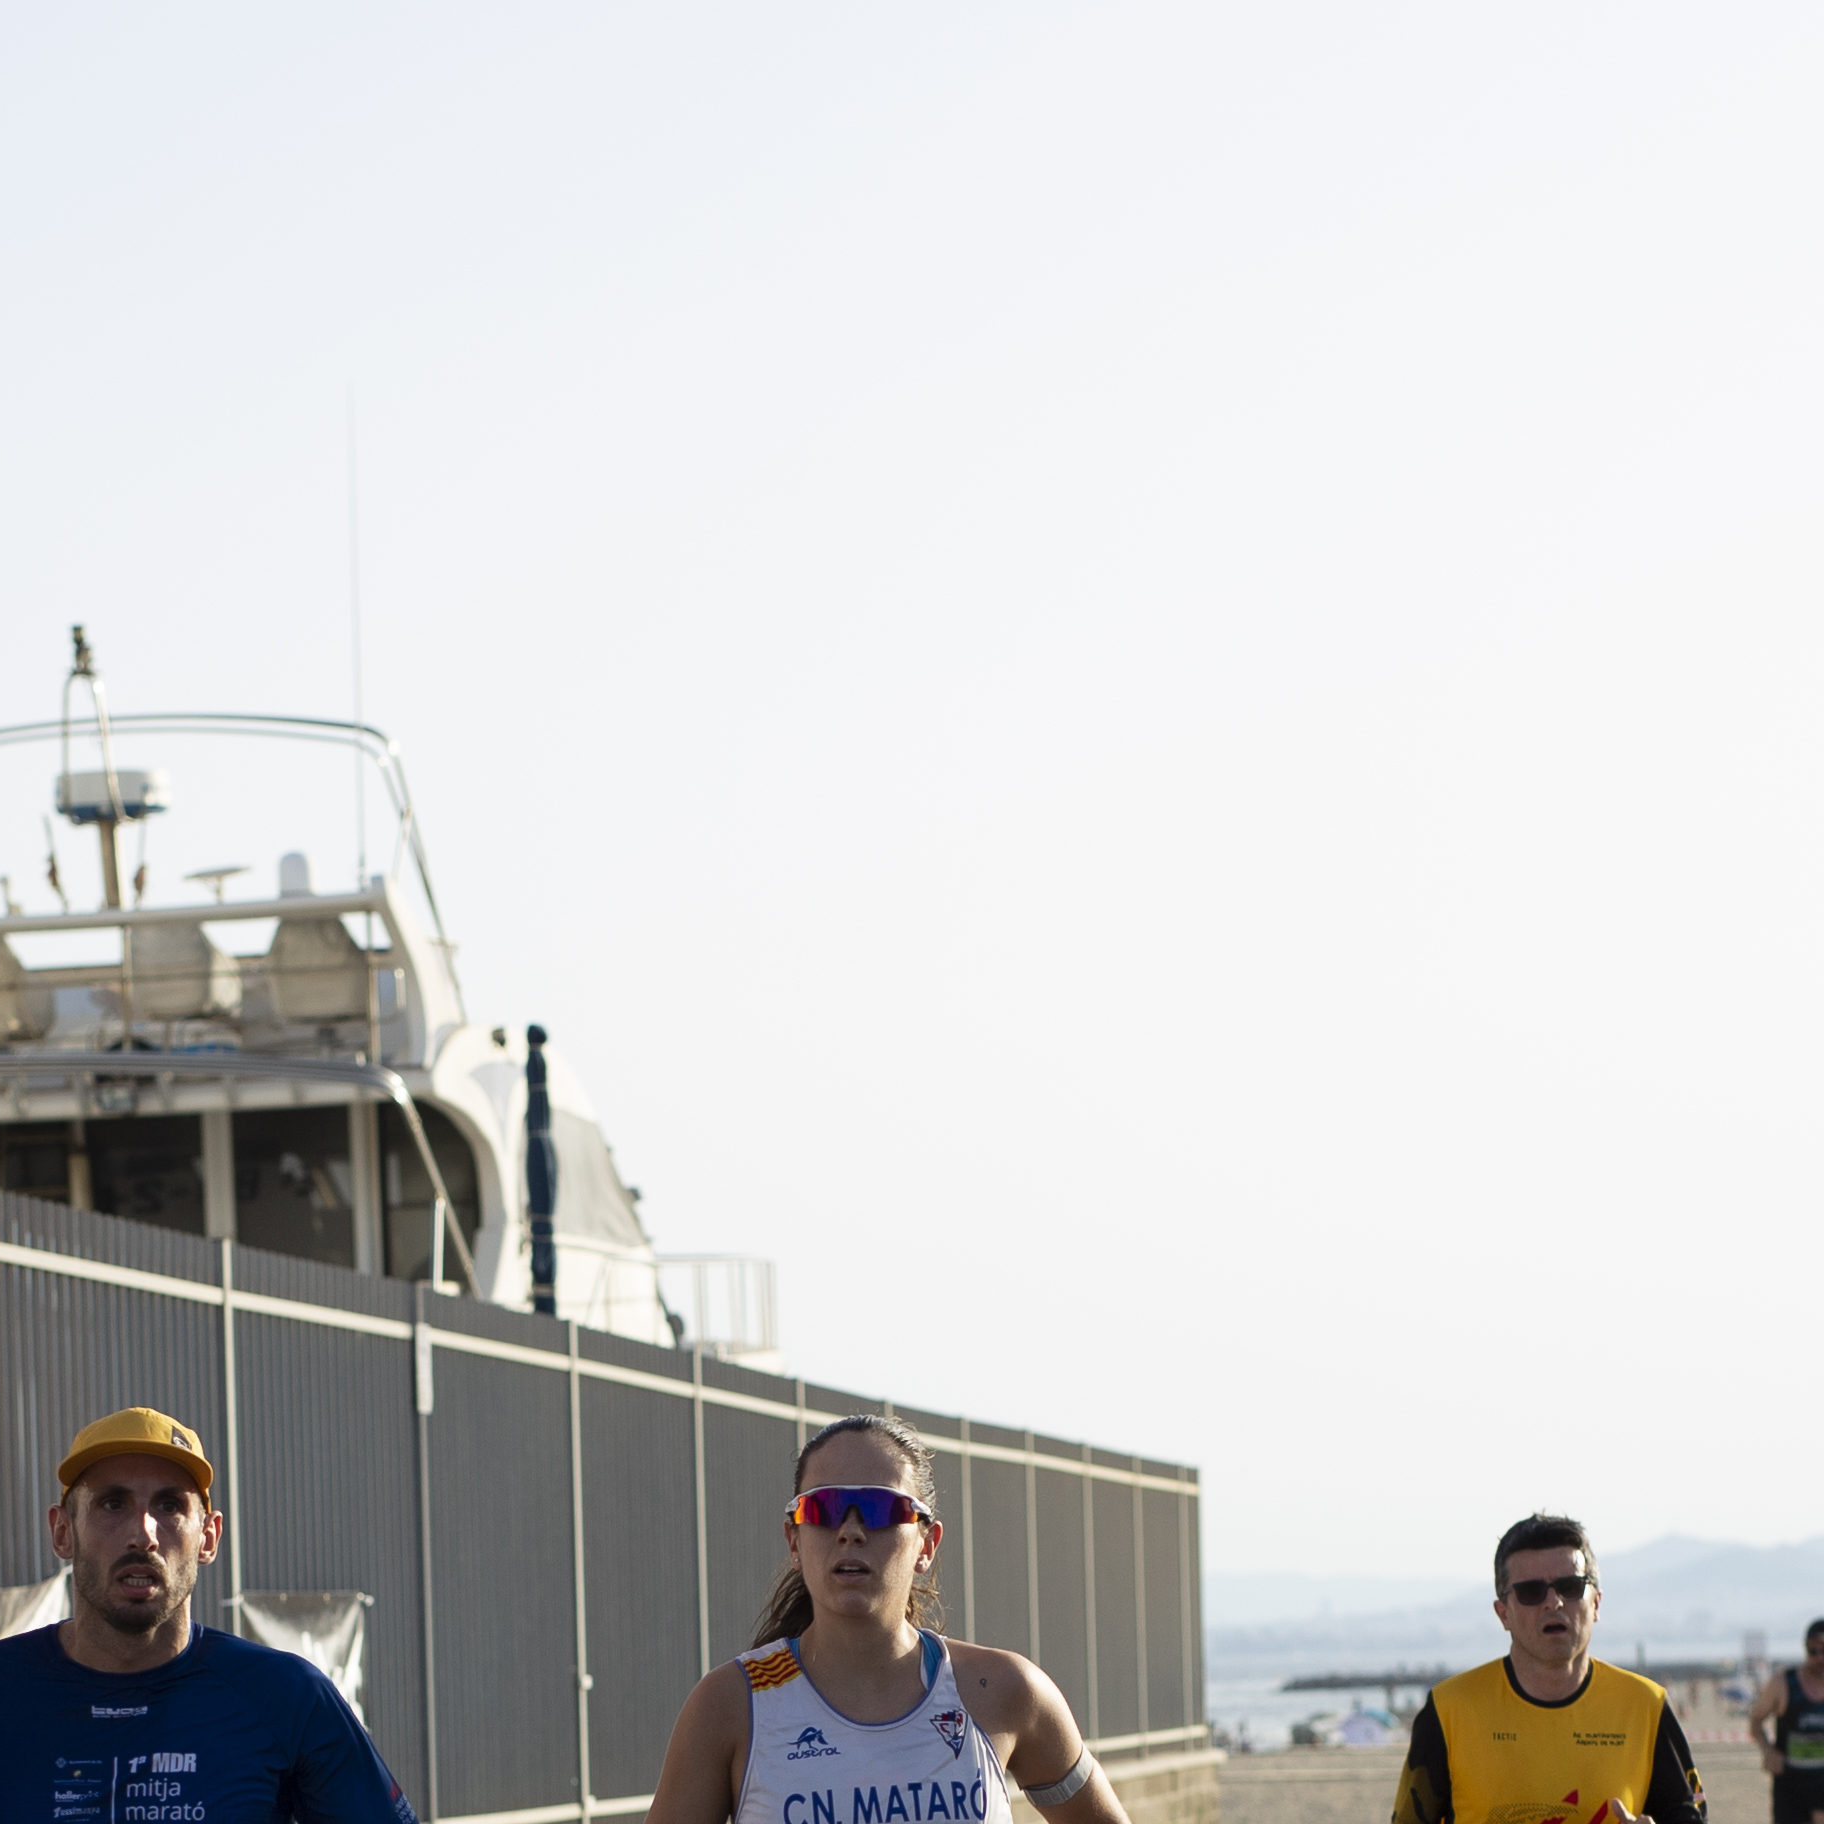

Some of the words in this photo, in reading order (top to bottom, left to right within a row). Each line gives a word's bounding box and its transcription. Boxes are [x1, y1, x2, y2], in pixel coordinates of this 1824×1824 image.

[152, 1753, 197, 1773] MDR
[126, 1778, 181, 1802] mitja
[125, 1801, 206, 1821] marató
